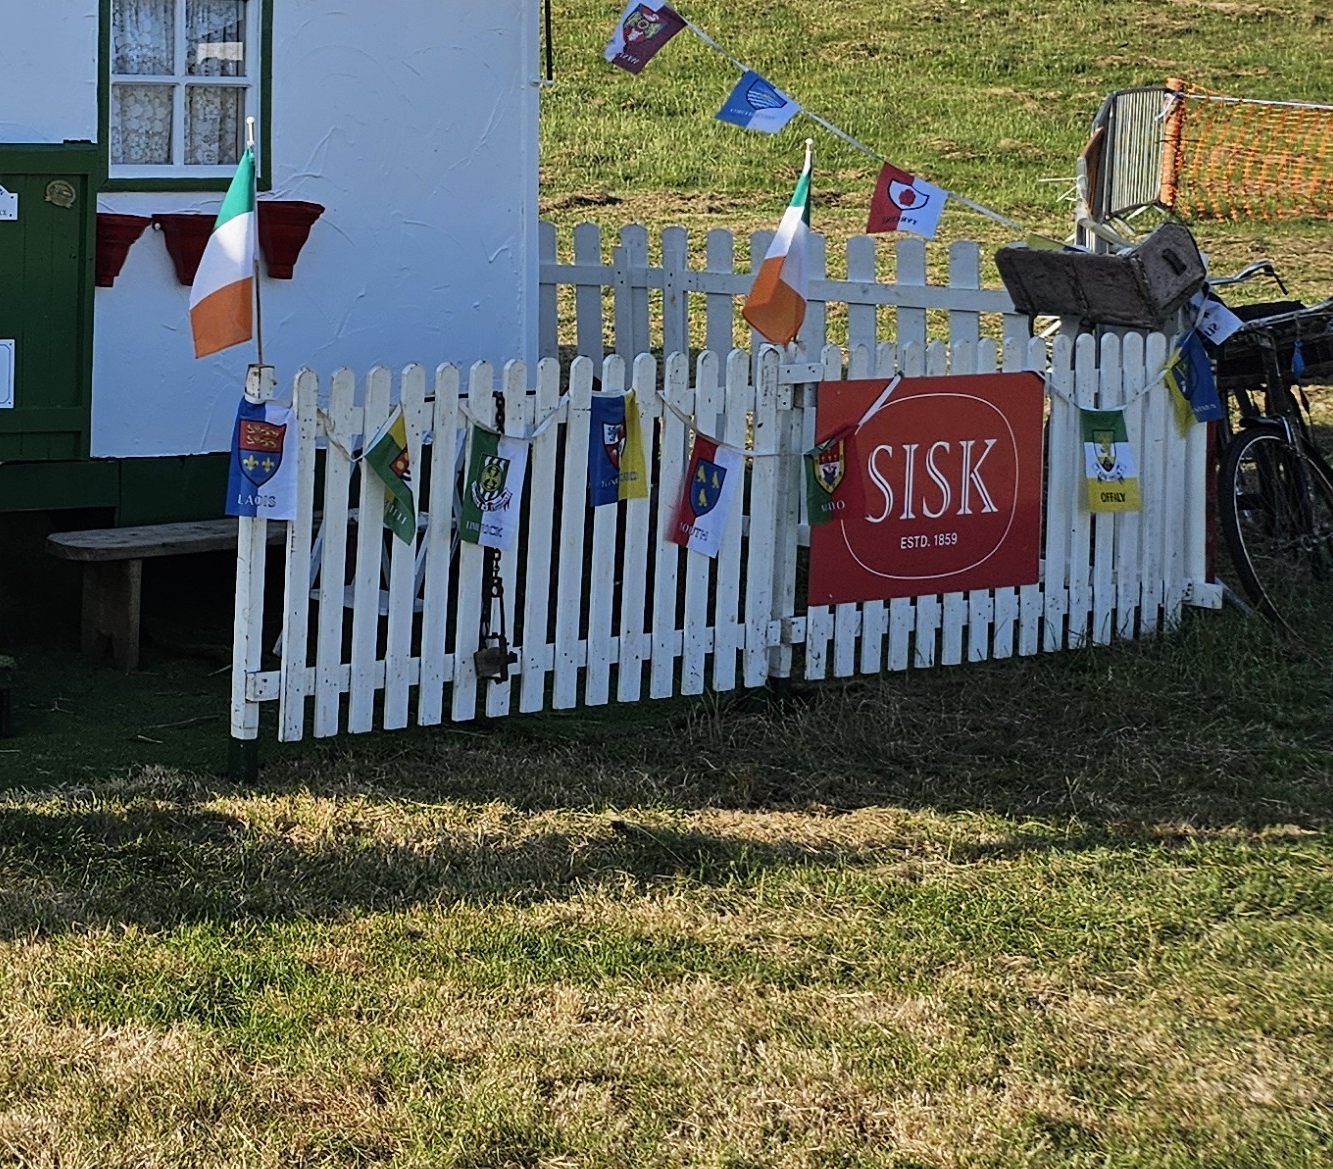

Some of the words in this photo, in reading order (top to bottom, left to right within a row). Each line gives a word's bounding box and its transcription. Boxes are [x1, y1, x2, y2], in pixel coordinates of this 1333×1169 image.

[865, 438, 999, 524] SISK
[237, 493, 277, 508] LAOIS
[1100, 491, 1126, 503] OFFALY
[900, 534, 931, 550] ESTD.
[933, 532, 958, 546] 1859
